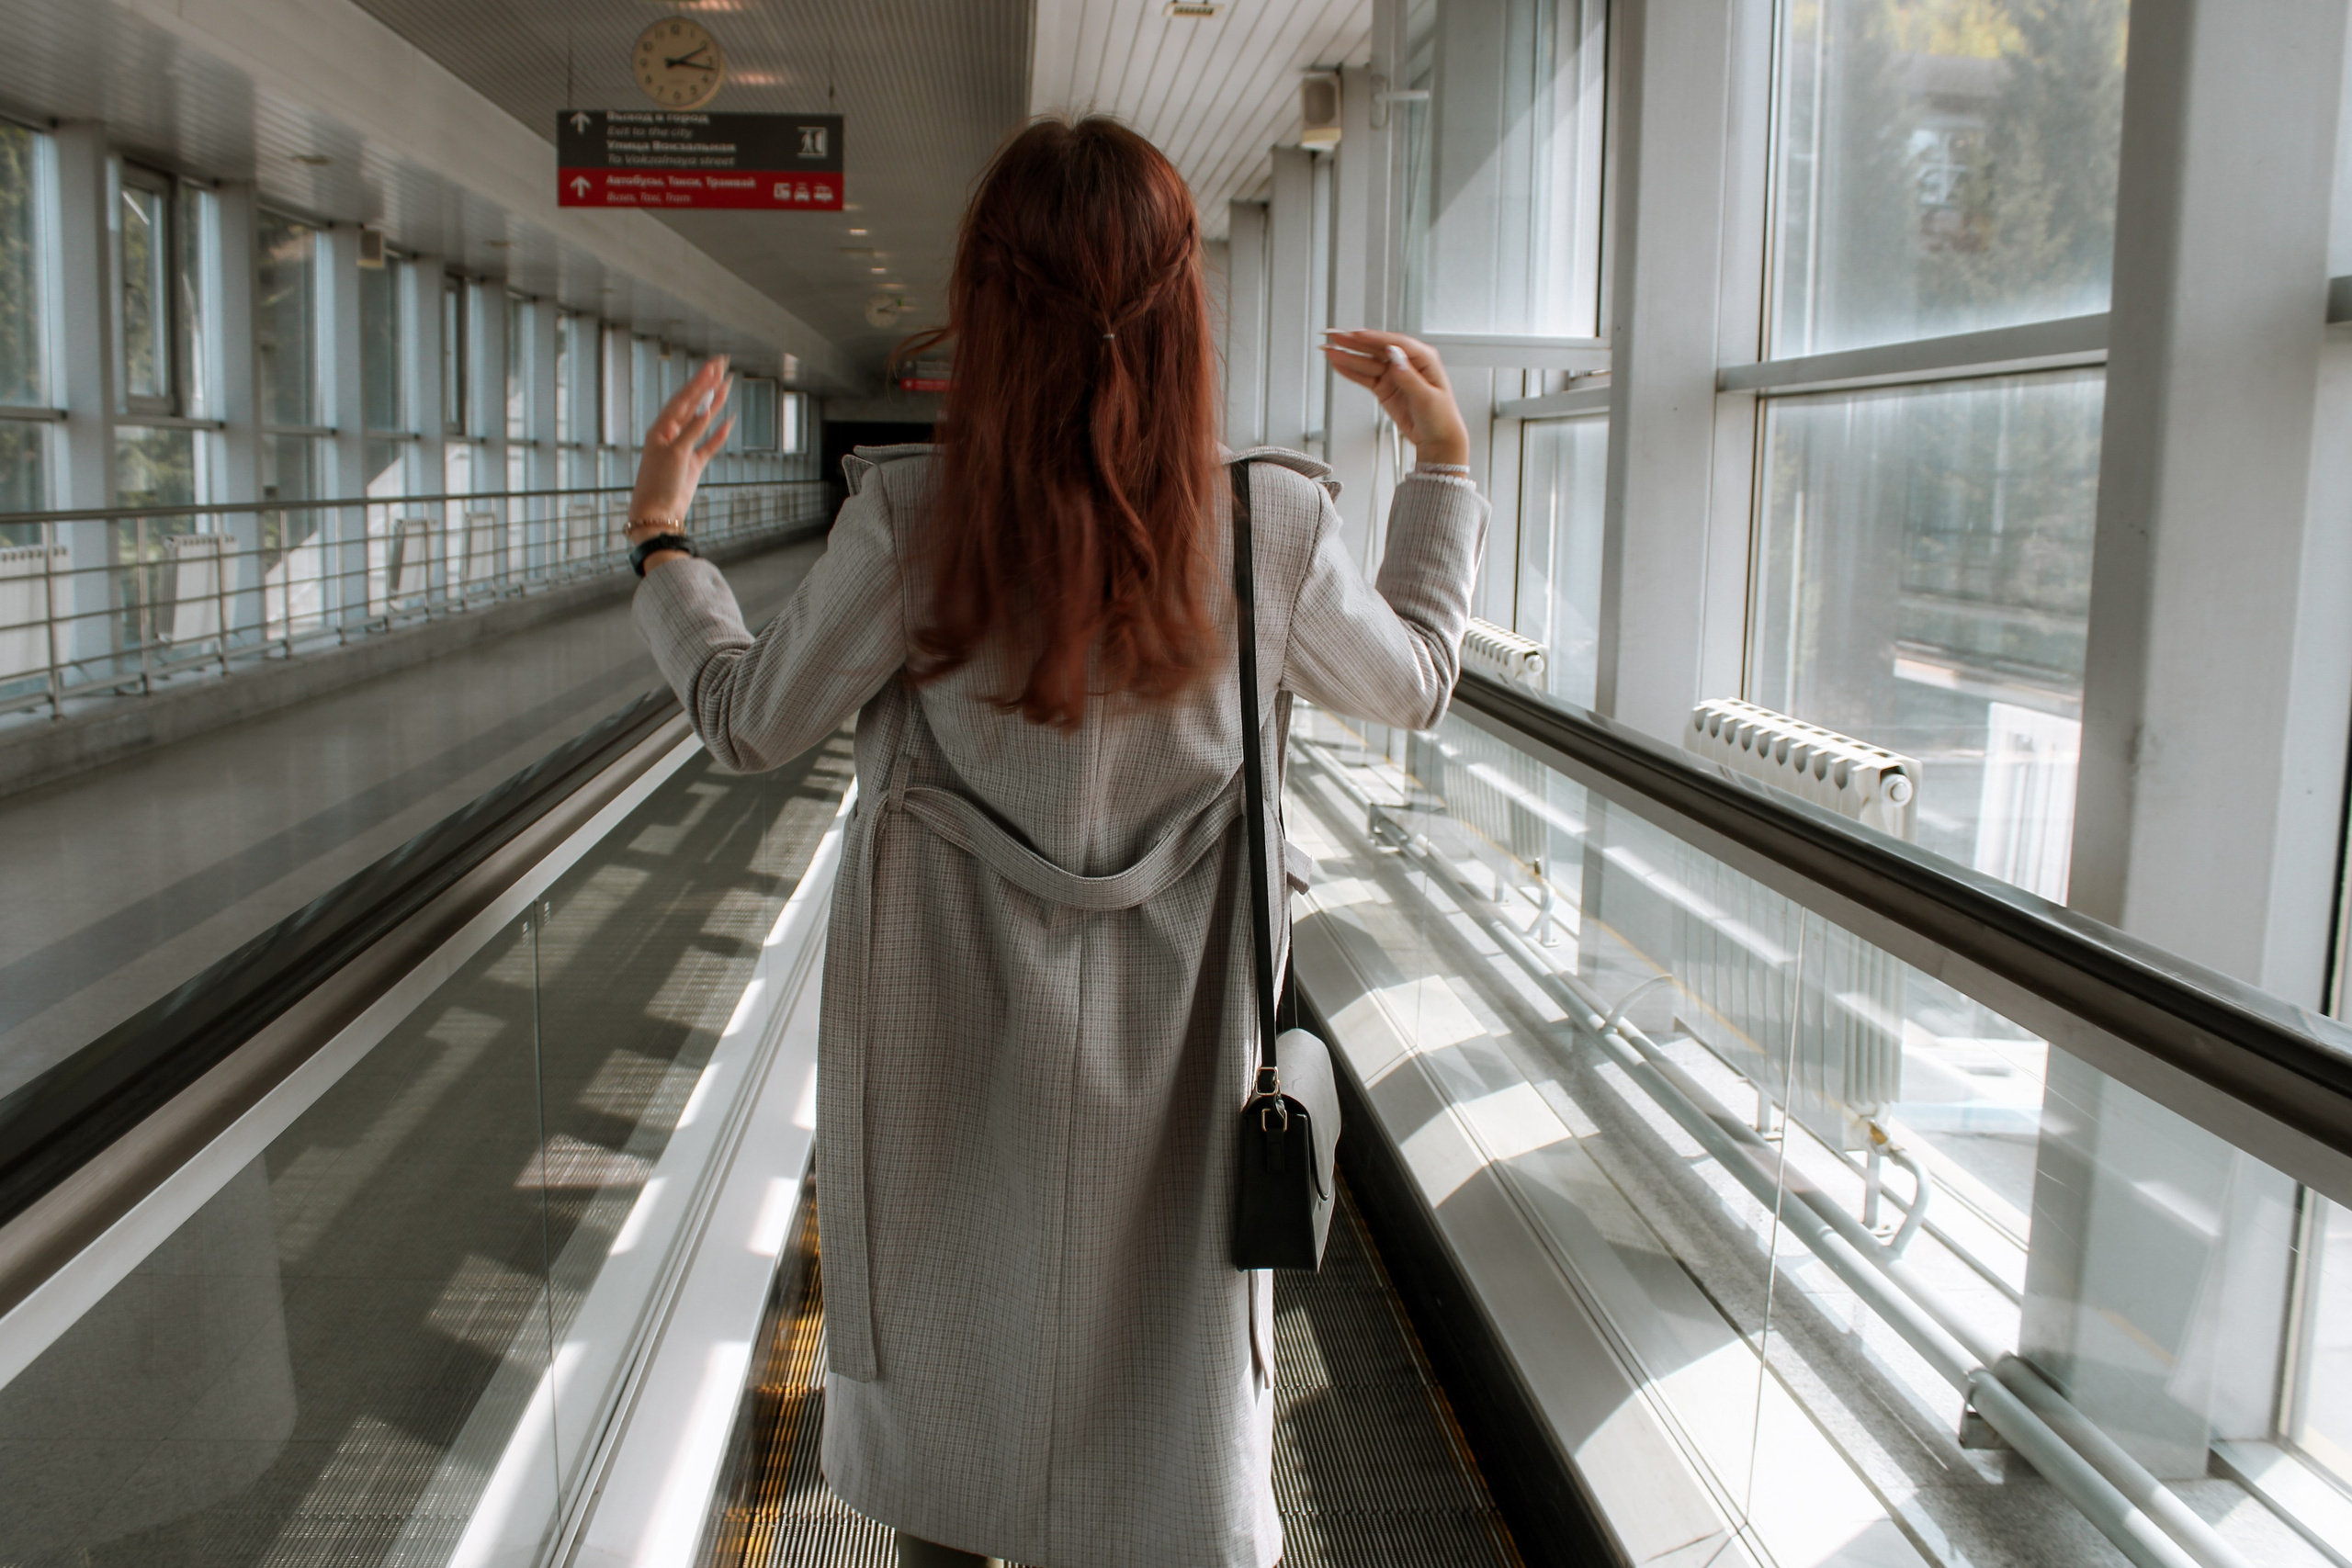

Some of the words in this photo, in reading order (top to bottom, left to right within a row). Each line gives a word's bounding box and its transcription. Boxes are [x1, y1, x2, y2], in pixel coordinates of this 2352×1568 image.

[670, 24, 681, 36] 12
[642, 41, 653, 52] 10
[606, 111, 652, 122] Выход
[655, 113, 663, 121] в
[666, 113, 709, 124] город
[606, 126, 630, 135] Exit
[632, 127, 647, 135] to
[649, 127, 668, 136] the
[671, 128, 693, 137] city
[606, 140, 650, 151] Улица
[652, 141, 737, 152] Вокзальная
[608, 153, 622, 163] To
[625, 154, 696, 165] Vokzalnaya
[699, 156, 735, 166] street
[606, 175, 664, 187] Автобусы,
[668, 175, 703, 186] Такси,
[706, 176, 756, 189] Трамвай
[606, 191, 637, 202] Buses,
[640, 192, 662, 203] Taxi,
[666, 192, 691, 202] Tram
